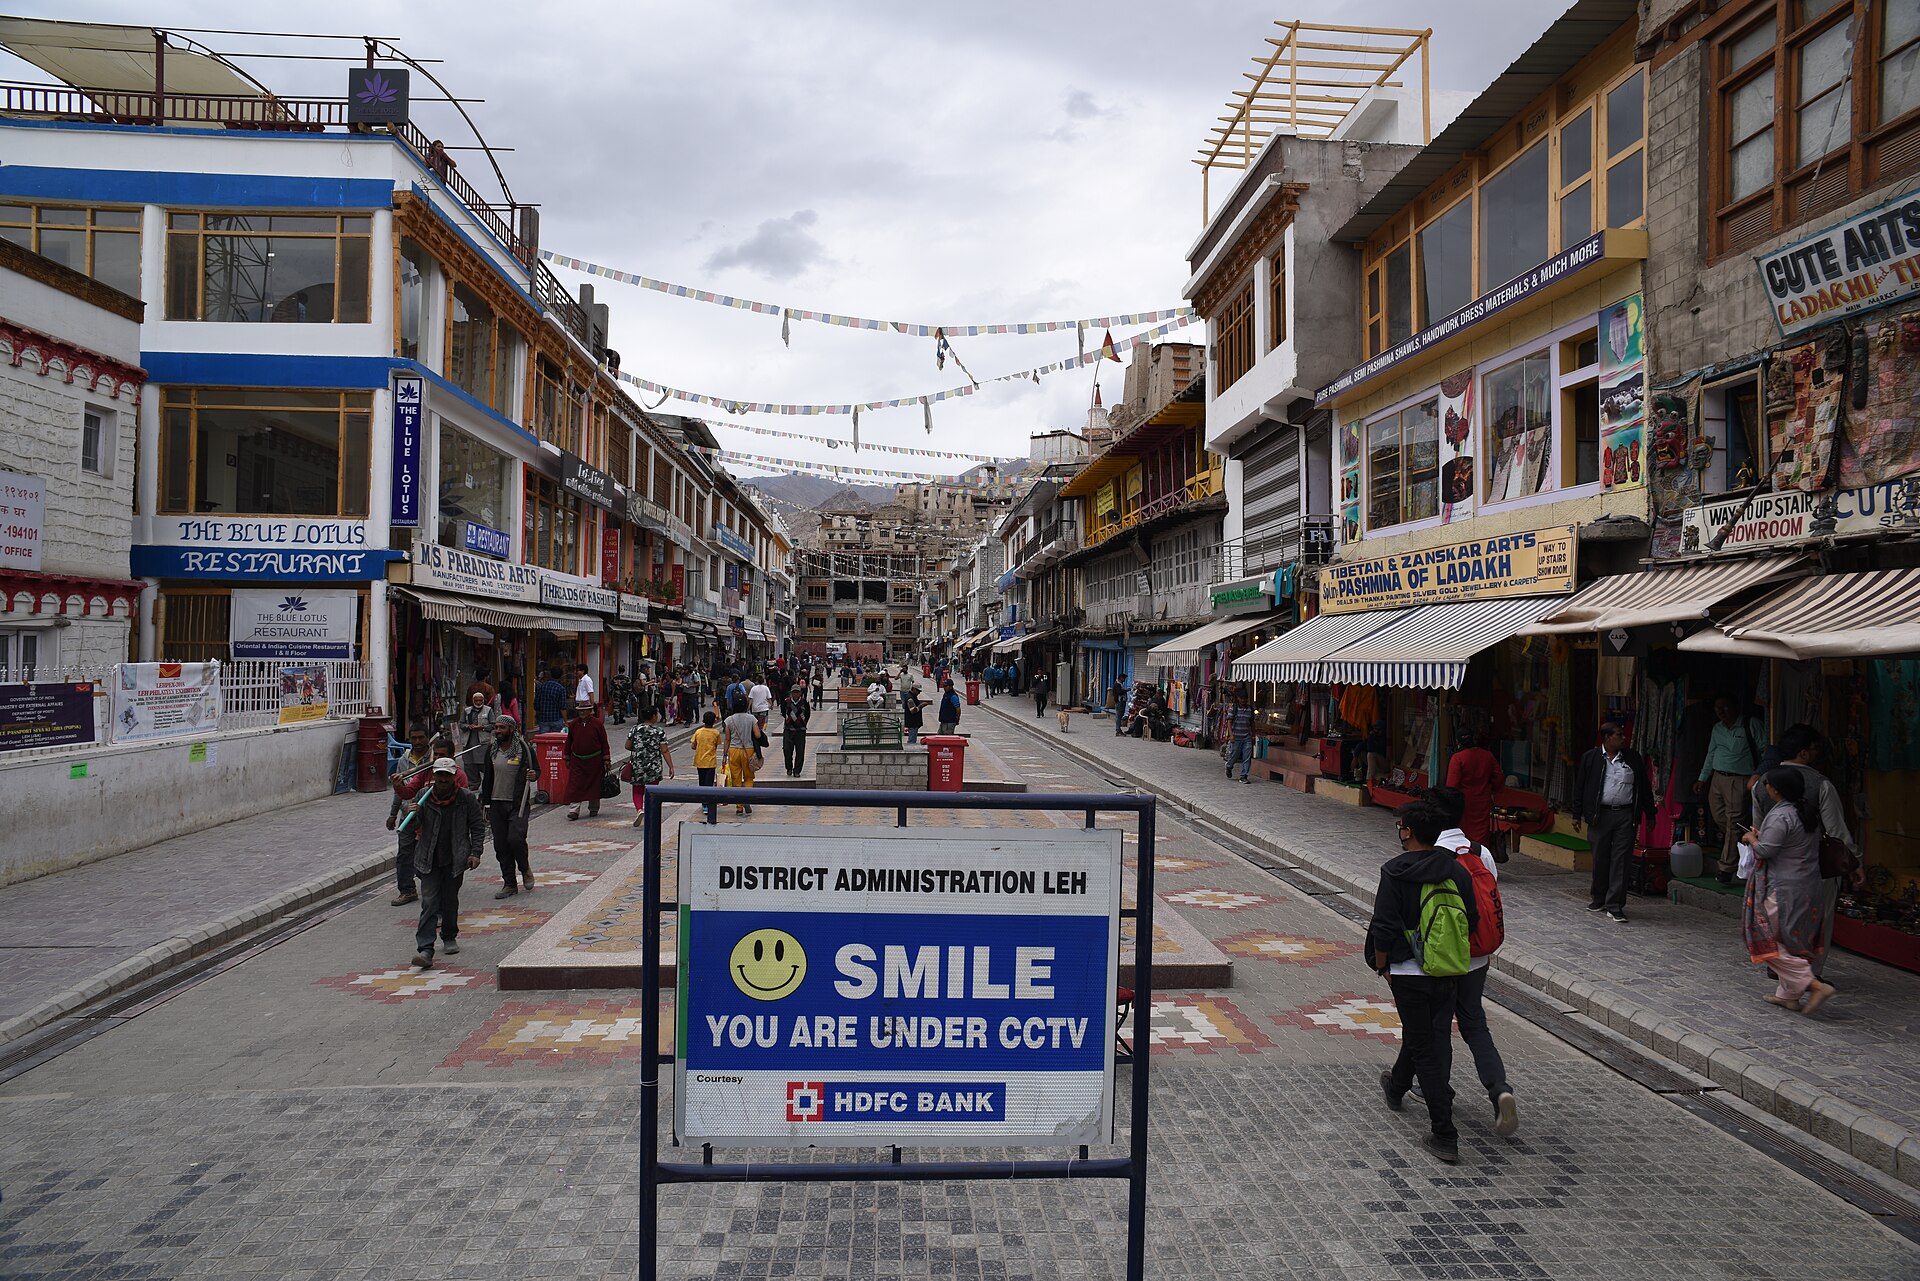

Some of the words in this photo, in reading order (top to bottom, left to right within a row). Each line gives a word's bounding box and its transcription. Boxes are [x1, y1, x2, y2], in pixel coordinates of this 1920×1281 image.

[1765, 238, 1843, 299] CUTE
[1843, 200, 1920, 272] ARTS
[1778, 273, 1879, 327] LADAKHI
[1846, 303, 1861, 312] MAIN
[1868, 290, 1898, 305] MARKET
[1316, 389, 1328, 402] PURE
[1328, 376, 1354, 396] PASHMINA,
[1354, 367, 1366, 382] SEMI
[1367, 353, 1395, 375] PASHMINA
[1395, 338, 1422, 360] SHAWLS,
[1422, 316, 1460, 345] HANDWORK
[1460, 303, 1484, 325] DRESS
[1485, 278, 1529, 312] MATERIALS
[1532, 273, 1538, 288] &
[1540, 258, 1568, 283] MUCH
[1570, 240, 1599, 268] MORE
[404, 416, 412, 457] BLUE
[402, 464, 412, 514] LOTUS
[1710, 506, 1736, 526] WAY
[1756, 500, 1772, 519] UP
[178, 521, 223, 541] THE
[227, 523, 288, 542] BLUE
[291, 524, 365, 545] LOTUS
[477, 529, 510, 558] RESTAURANT
[5, 546, 32, 558] OFFICE
[1330, 560, 1384, 579] TIBETAN
[1388, 558, 1398, 572] &
[1401, 543, 1482, 568] ZANSKAR
[1486, 532, 1536, 555] ARTS
[1538, 556, 1546, 565] UP
[1546, 554, 1566, 564] STAIRS
[1544, 544, 1556, 553] WAY
[1558, 542, 1566, 551] TO
[180, 552, 366, 574] RESTAURANT
[447, 550, 506, 580] PARADISE
[508, 565, 536, 586] ARTS
[1338, 572, 1402, 598] PASHMINA
[1408, 568, 1428, 589] OF
[1436, 554, 1512, 586] LADAKH
[1538, 567, 1551, 576] SHOW
[1552, 565, 1568, 574] ROOM
[432, 570, 478, 586] MANUFACTURERS
[497, 581, 525, 592] EXPORTERS
[1361, 595, 1385, 603] THANKA
[1413, 589, 1437, 598] SILVER
[1440, 586, 1458, 595] GOLD
[1460, 581, 1502, 592] JEWELLERY
[1509, 576, 1538, 586] CARPETS
[544, 583, 578, 602] THREADS
[579, 590, 586, 602] OF
[588, 591, 616, 607] KASHMIR
[254, 628, 328, 638] RESTAURANT
[720, 866, 828, 892] DISTRICT
[834, 868, 1036, 894] ADMINISTRATION
[1043, 871, 1087, 894] LEH
[834, 944, 1056, 1000] SMILE
[706, 1014, 778, 1048] YOU
[789, 1015, 858, 1048] ARE
[870, 1016, 988, 1048] UNDER
[998, 1017, 1088, 1049] CCTV
[696, 1074, 744, 1084] Courtesy
[834, 1092, 908, 1112] HDFC
[918, 1092, 994, 1112] BANK
